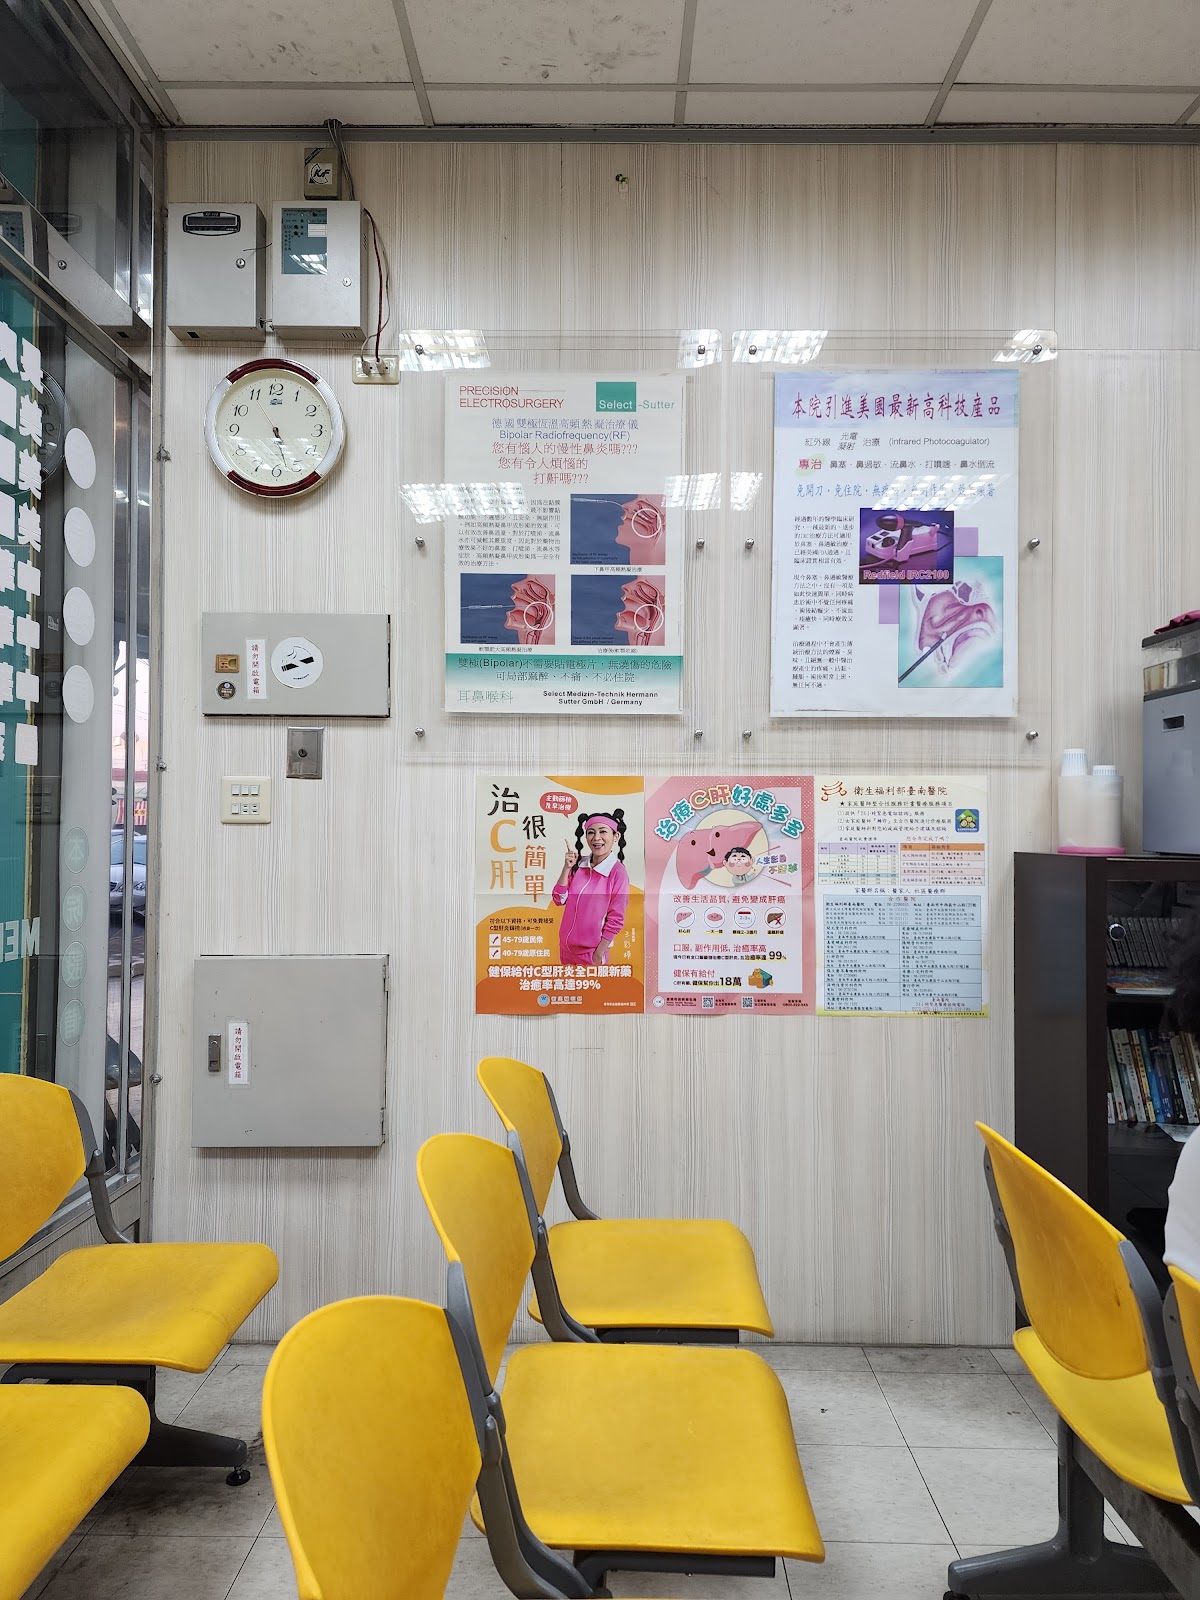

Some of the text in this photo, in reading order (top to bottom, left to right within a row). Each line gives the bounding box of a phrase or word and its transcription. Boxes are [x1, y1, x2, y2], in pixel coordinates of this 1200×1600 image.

[250, 388, 261, 400] 11
[269, 384, 283, 395] 12
[459, 386, 519, 396] PRECISION
[295, 390, 300, 402] 1
[459, 398, 564, 409] ELECTROSURGERY
[599, 400, 633, 410] Select
[792, 392, 1001, 420] 本院引進美國最新高科技產品
[234, 405, 248, 417] 10
[305, 405, 317, 417] 2
[229, 423, 240, 436] 9
[311, 424, 323, 437] 3
[499, 430, 631, 441] Bipolar Radiofrequency(RF)
[805, 438, 831, 446] 紅外線
[863, 438, 880, 446] 治療
[236, 445, 247, 456] 8
[491, 442, 638, 455] 您有惱人的慢性鼻炎嗎???
[253, 460, 263, 472] 7
[291, 460, 303, 472] 5
[498, 457, 588, 470] 您有令人煩惱的
[799, 459, 822, 470] 專治
[271, 464, 282, 478] 6
[533, 473, 589, 485] 打鼾嗎???
[863, 569, 950, 580] Redfield IRC2100
[251, 644, 260, 694] 請勿開啟電箱
[457, 690, 514, 704] 耳鼻喉科
[854, 786, 948, 796] 衛生福利部臺南醫院
[654, 784, 805, 841] 治療C肝好處多多
[487, 784, 520, 890] 治C肝
[522, 815, 547, 903] 很簡單
[502, 936, 544, 944] 45-79歲民眾
[488, 966, 632, 978] 健保給付C型肝炎全口服新藥
[673, 969, 715, 977] 健保有給付
[519, 979, 601, 991] 治癒率高達99%
